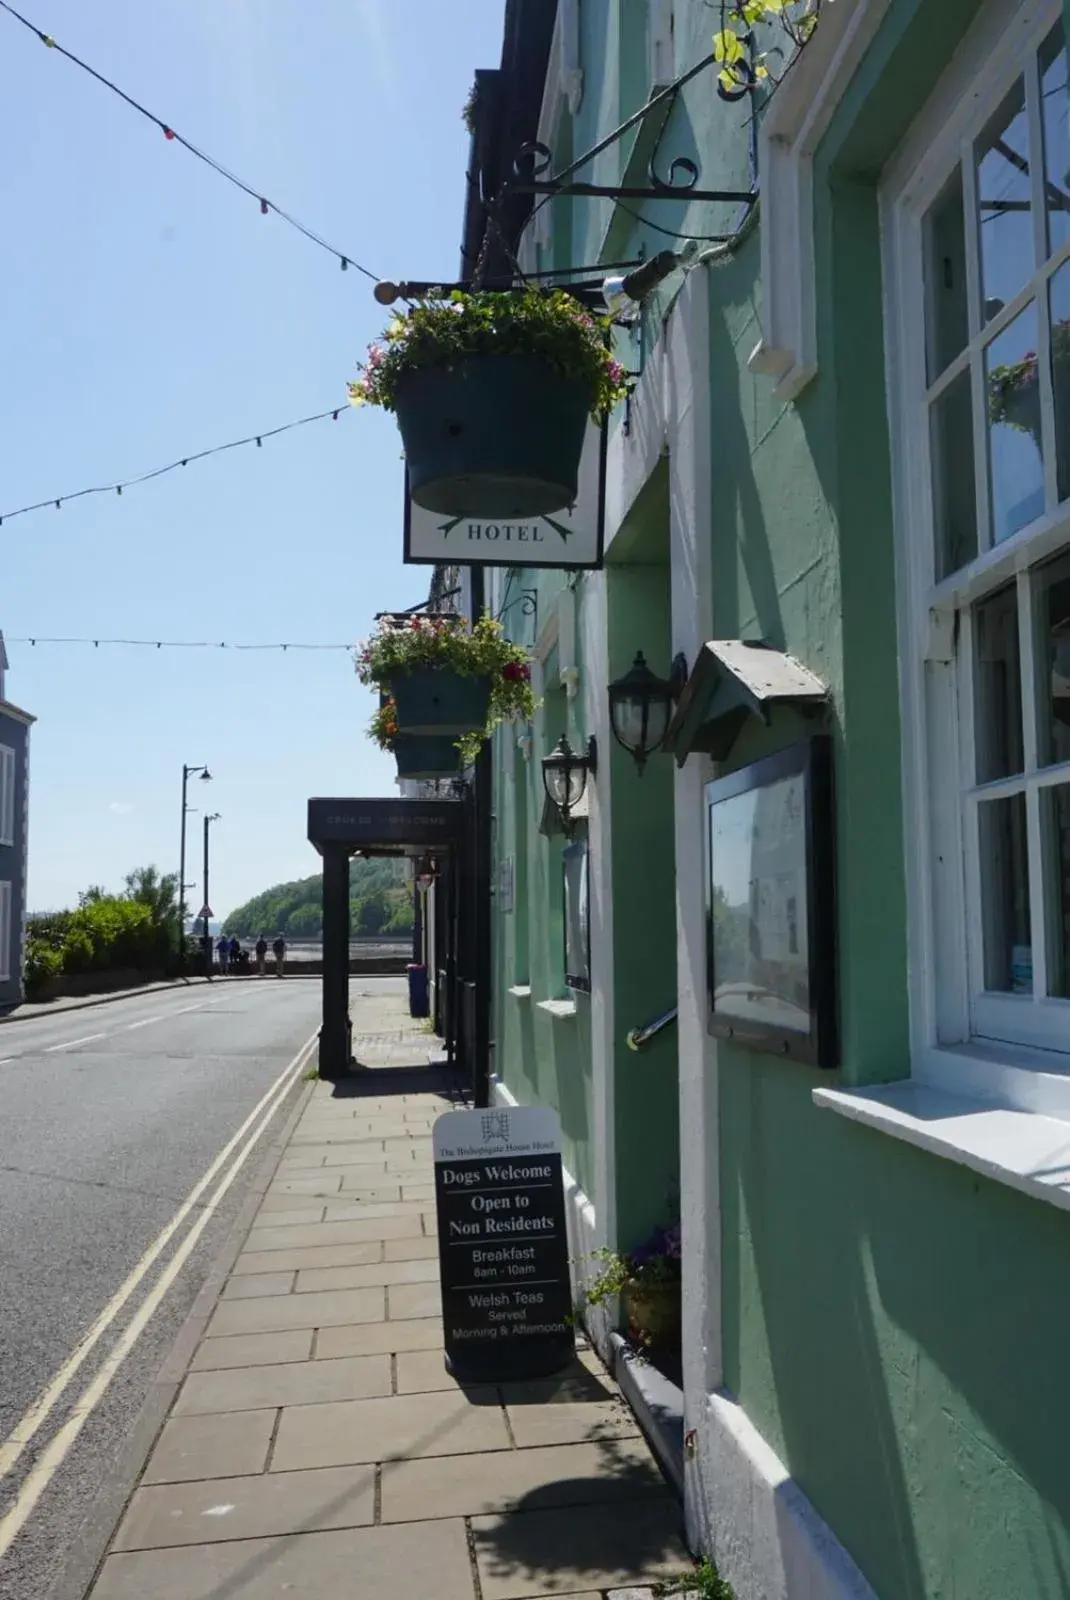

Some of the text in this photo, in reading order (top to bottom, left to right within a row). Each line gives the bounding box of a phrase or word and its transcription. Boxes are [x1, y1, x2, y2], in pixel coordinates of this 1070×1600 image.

[467, 523, 544, 542] HOTEL
[440, 1147, 455, 1157] The
[506, 1143, 530, 1152] House
[532, 1140, 555, 1150] Hotel
[442, 1164, 552, 1186] Dogs Welcome
[471, 1194, 530, 1213] Open to
[449, 1215, 555, 1236] Non Residents
[472, 1247, 535, 1263] Breakfast
[473, 1266, 497, 1278] 8am
[507, 1264, 536, 1276] 10am
[468, 1291, 544, 1308] Welsh Teas
[488, 1307, 527, 1321] Served
[452, 1322, 566, 1340] Morning & Afternoon
